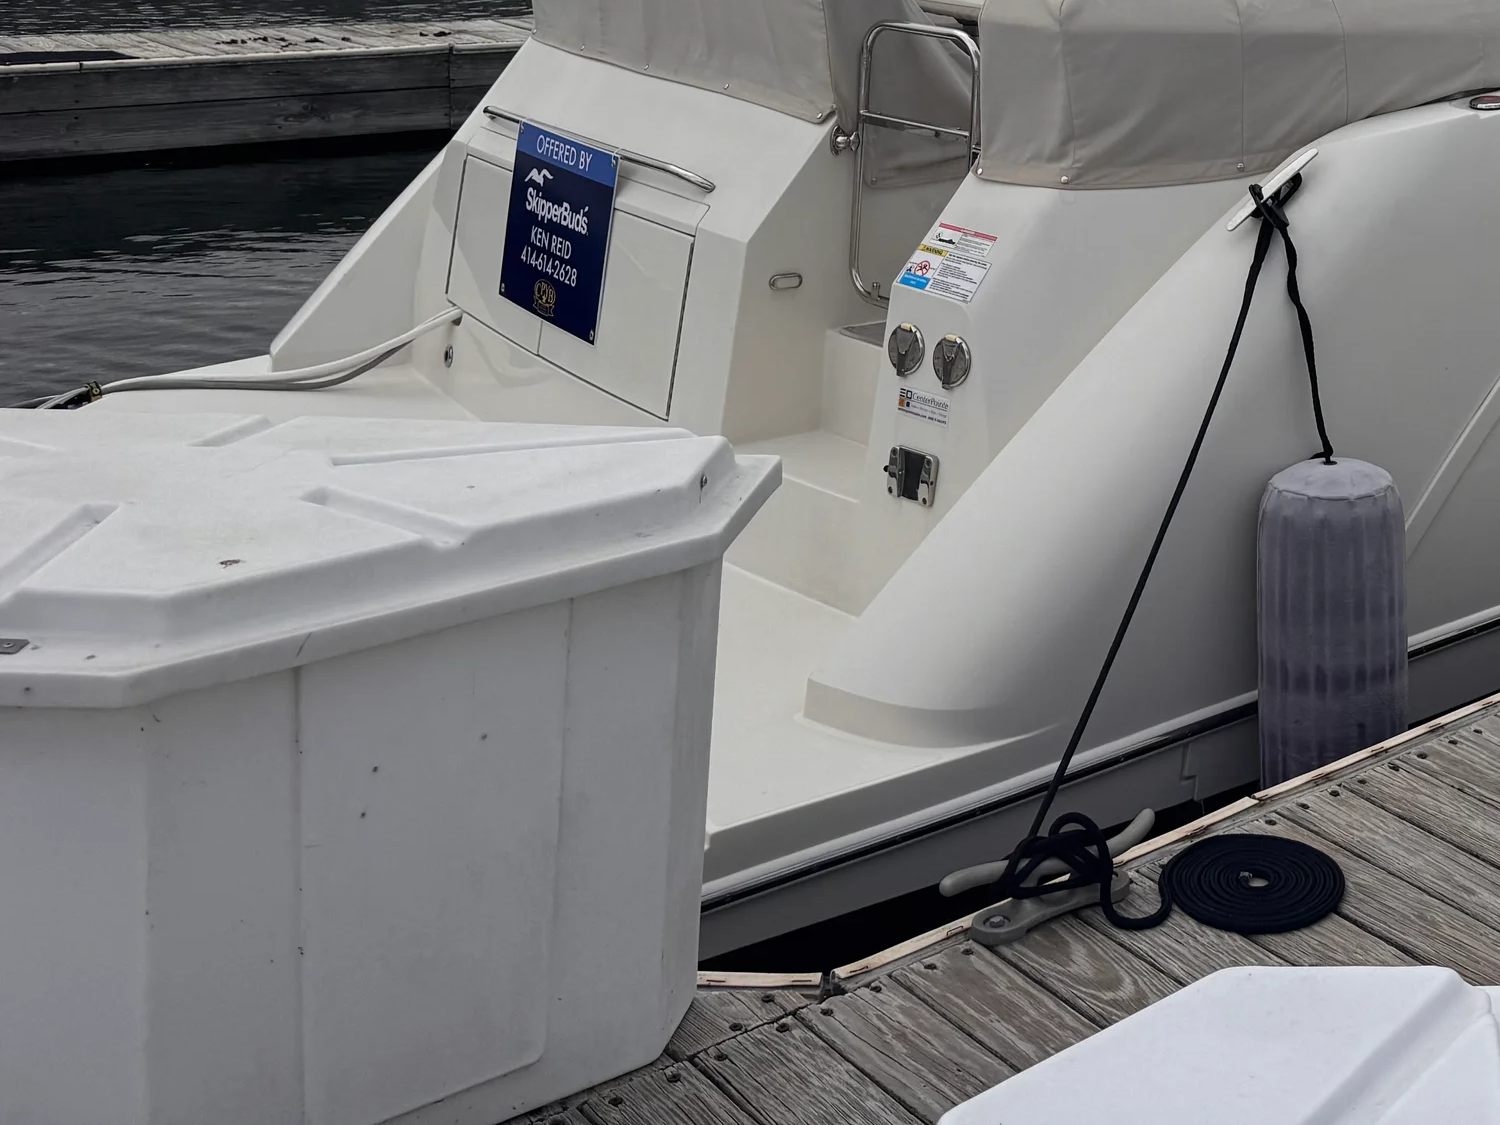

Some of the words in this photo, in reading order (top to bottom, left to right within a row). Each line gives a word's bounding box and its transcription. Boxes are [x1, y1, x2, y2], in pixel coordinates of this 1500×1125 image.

[536, 134, 577, 166] OFFERED
[578, 150, 593, 172] BY
[530, 225, 550, 251] KEN
[551, 235, 572, 260] REID
[520, 245, 578, 287] 414-614-2628
